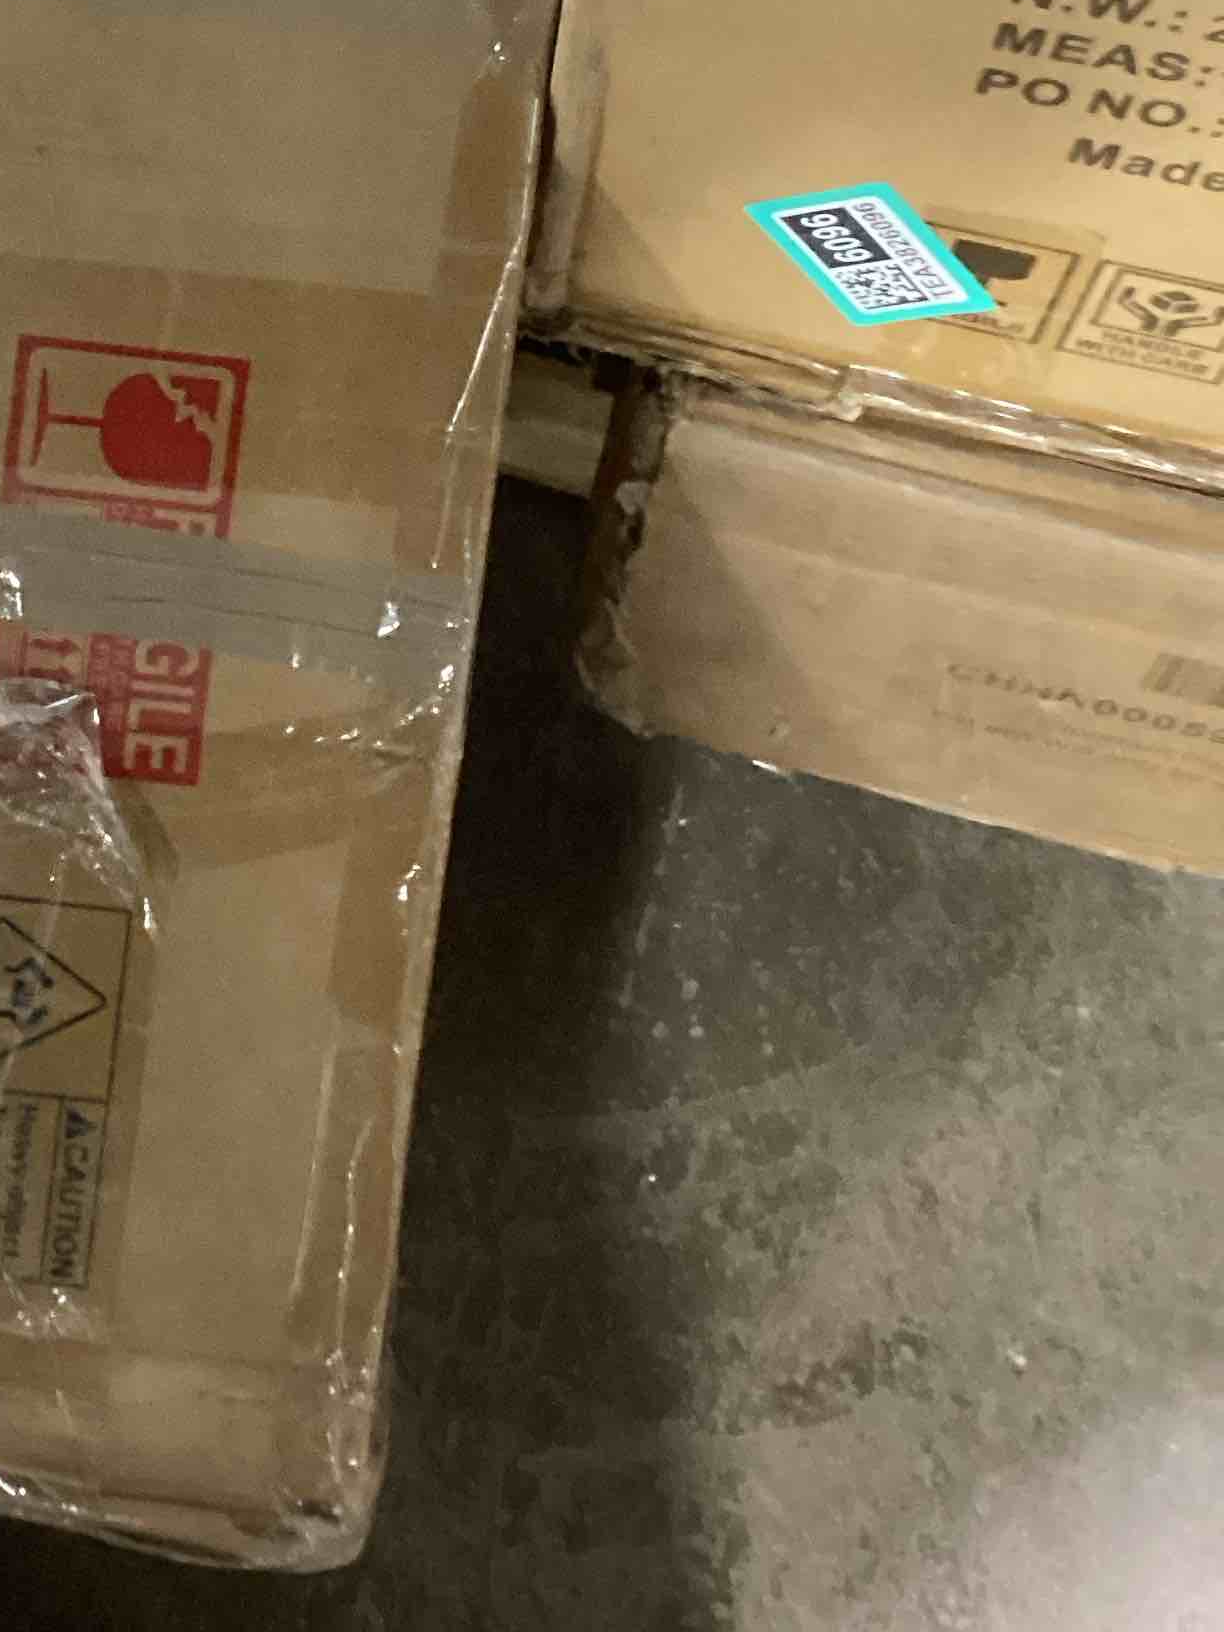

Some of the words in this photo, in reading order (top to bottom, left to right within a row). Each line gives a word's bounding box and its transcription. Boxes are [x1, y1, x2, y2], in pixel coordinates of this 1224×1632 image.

[991, 20, 1213, 88] MEAS:
[975, 67, 1070, 107] PO
[1068, 137, 1224, 193] Made
[799, 213, 874, 264] 6096
[51, 1144, 89, 1279] CAUTION
